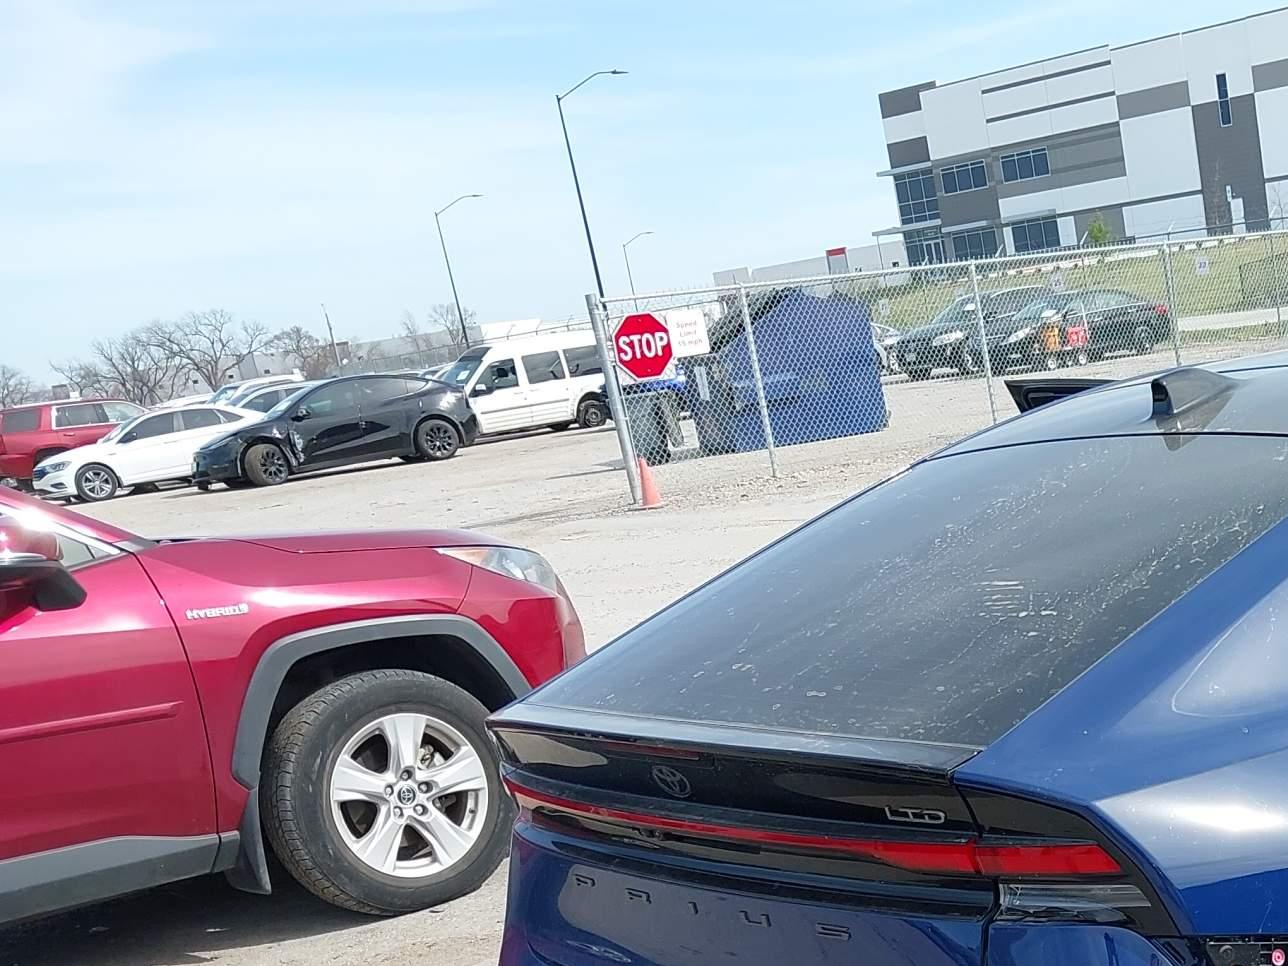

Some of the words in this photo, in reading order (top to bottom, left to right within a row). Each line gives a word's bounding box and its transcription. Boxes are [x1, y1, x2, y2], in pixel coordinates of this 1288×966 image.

[676, 320, 697, 329] Speed
[618, 331, 668, 361] STOP
[688, 338, 703, 347] mph
[884, 806, 945, 824] LTD
[574, 873, 851, 940] PRIUS
